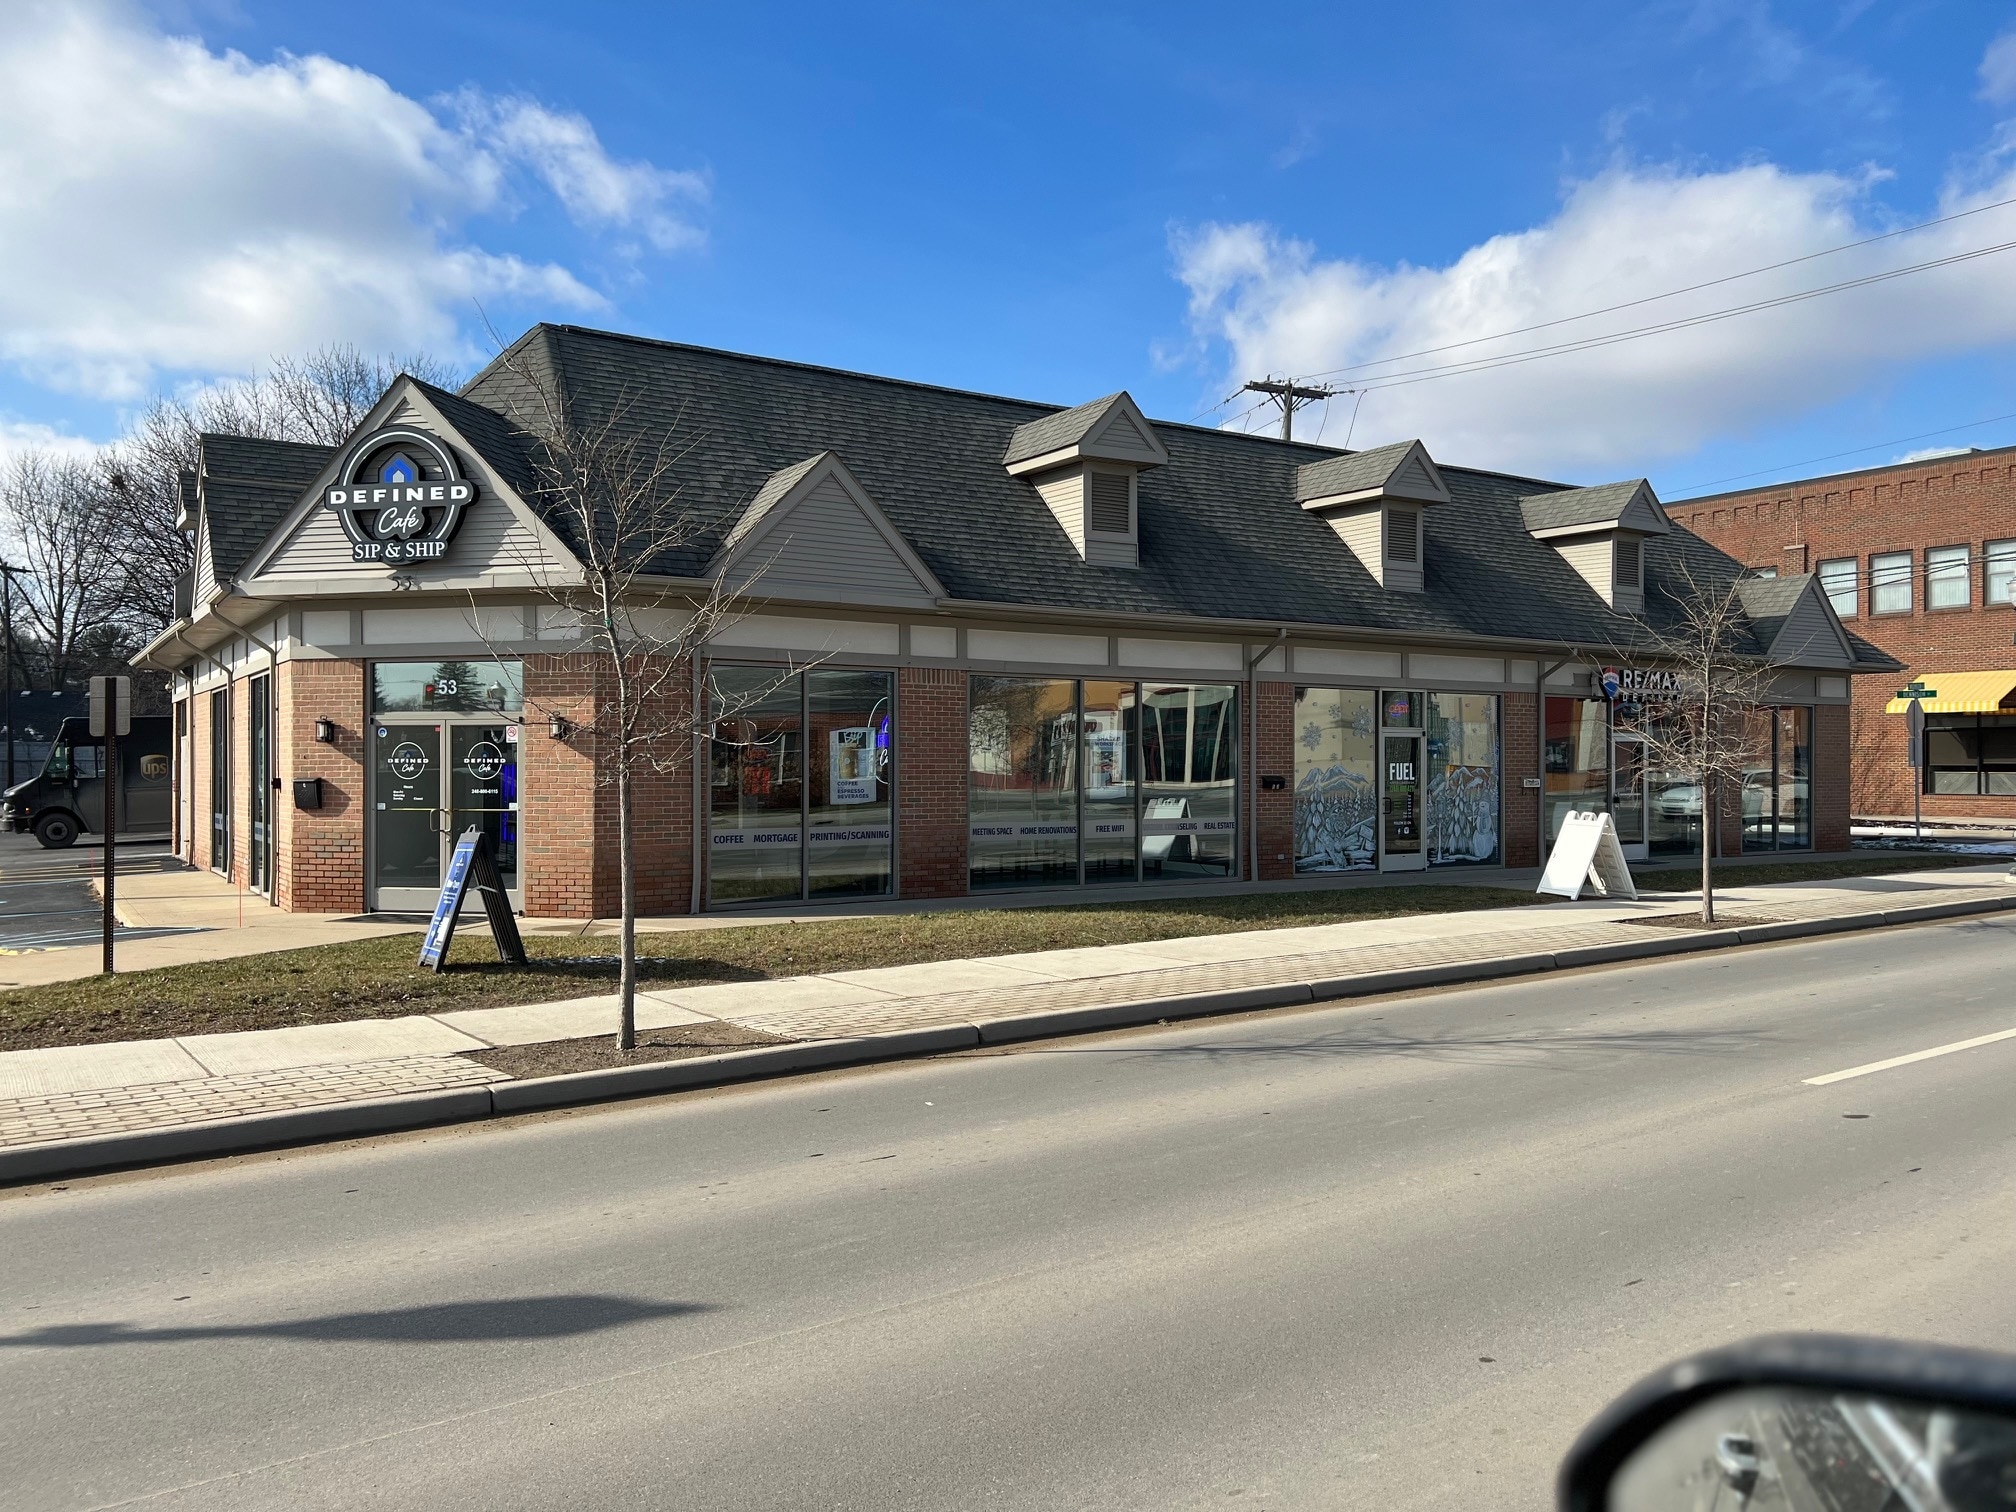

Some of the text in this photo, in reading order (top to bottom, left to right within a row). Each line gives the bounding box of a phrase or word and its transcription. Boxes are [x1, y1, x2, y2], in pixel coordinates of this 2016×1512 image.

[330, 485, 468, 505] DEFINED
[378, 506, 420, 534] Café
[354, 541, 446, 559] SIP & SHIP
[438, 679, 458, 695] 53
[1623, 669, 1681, 690] RE/MAX
[1389, 762, 1415, 781] FUEL
[972, 825, 1077, 836] MEETING SPACE HOME RENOVATIONS
[1095, 824, 1125, 833] FREE WIFI
[1203, 821, 1236, 830] REAL ESTATE
[713, 832, 798, 844] COFFEE MORTGAGE
[810, 830, 890, 841] PRINTING/SCANNING
